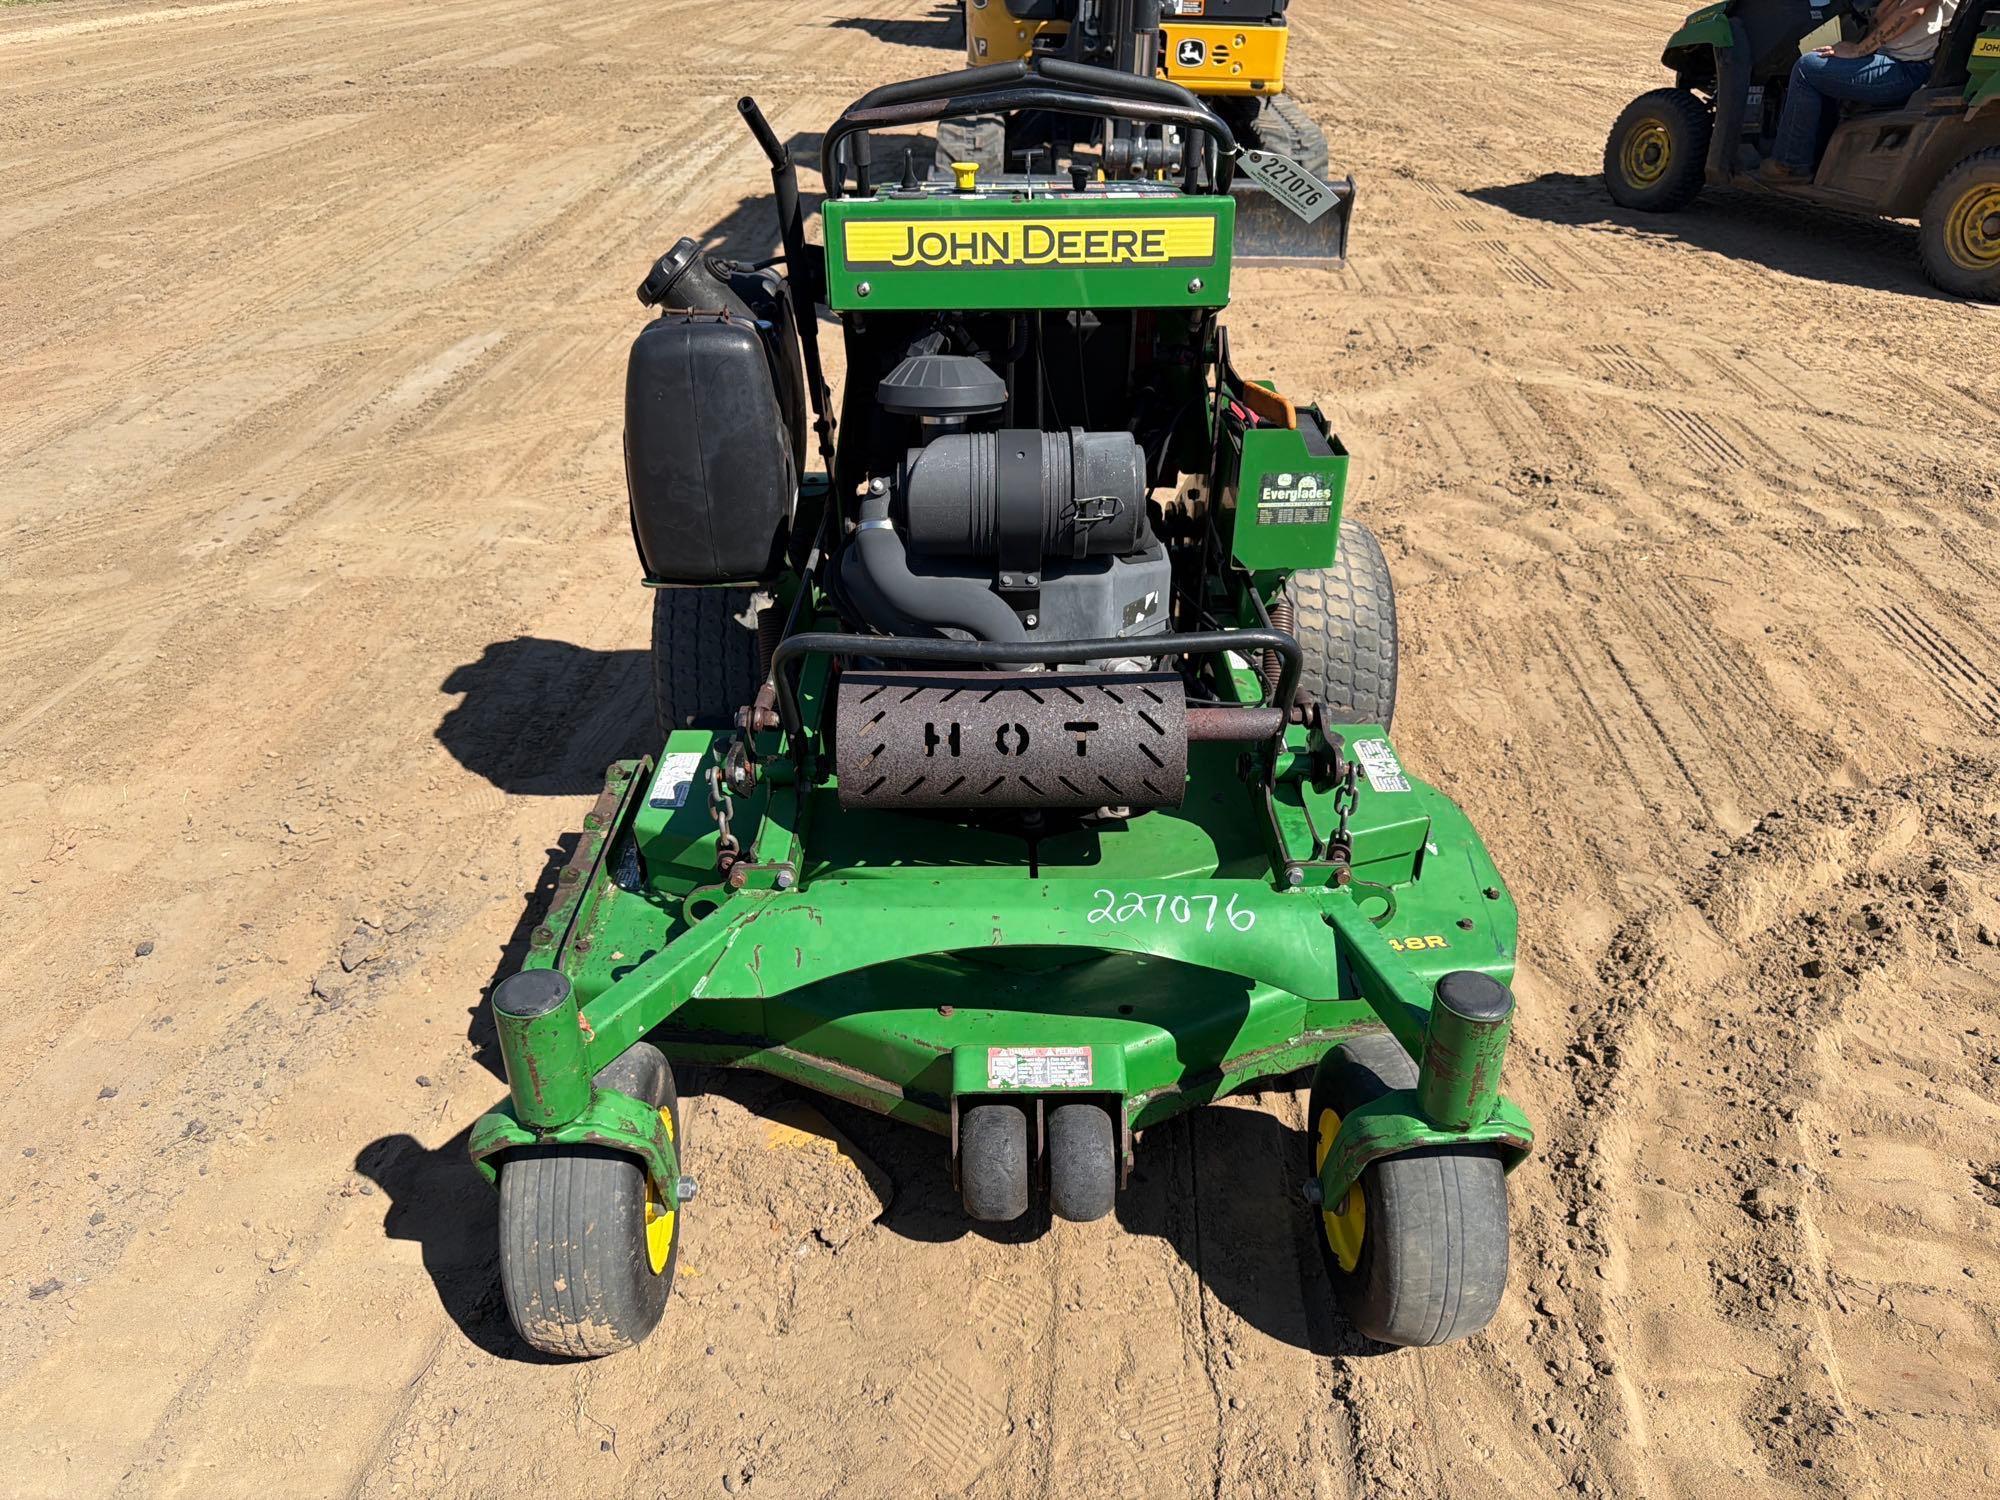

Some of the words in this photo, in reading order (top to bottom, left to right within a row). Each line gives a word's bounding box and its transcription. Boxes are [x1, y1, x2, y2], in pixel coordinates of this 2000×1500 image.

[1980, 43, 2000, 51] JOH
[1261, 157, 1323, 206] 227076
[892, 226, 1010, 262] JOHN
[1022, 224, 1166, 260] DEERE
[1262, 487, 1332, 503] Everglades
[925, 722, 1099, 757] HOT
[1087, 888, 1256, 933] 227076
